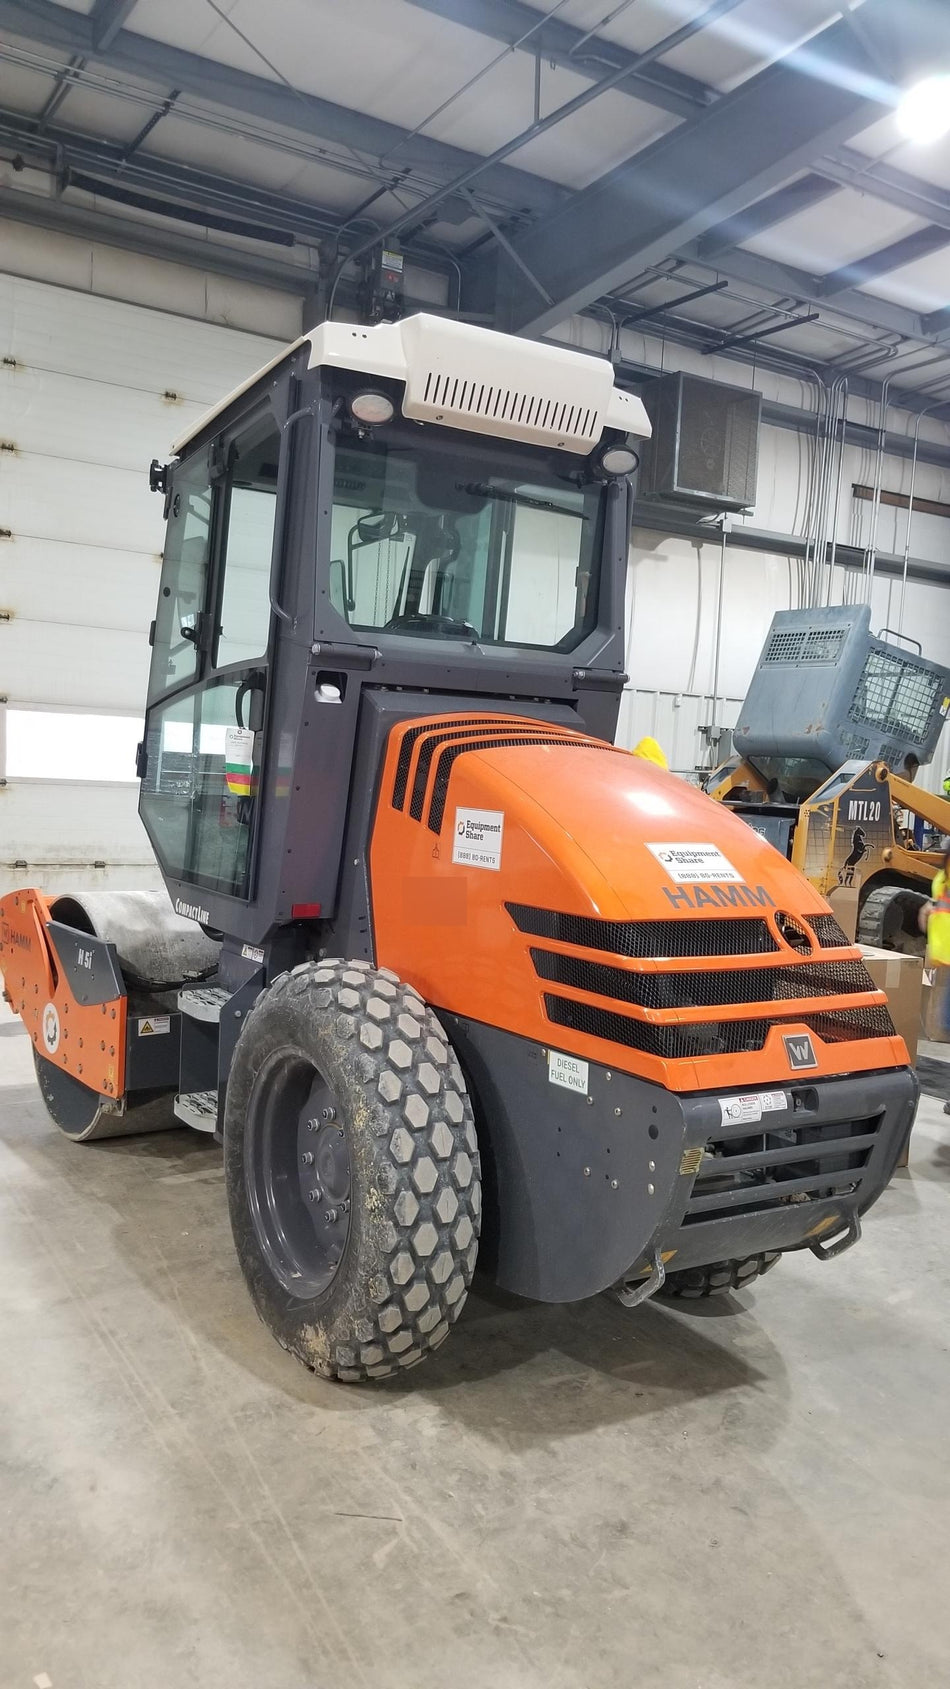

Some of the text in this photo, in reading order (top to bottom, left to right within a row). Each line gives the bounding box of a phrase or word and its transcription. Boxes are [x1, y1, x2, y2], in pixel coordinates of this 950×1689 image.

[848, 800, 881, 822] MTL20
[465, 830, 484, 841] Share
[466, 820, 501, 833] Equipment
[670, 850, 721, 858] Equipment
[662, 885, 777, 909] HAMM
[10, 929, 32, 952] HAMM
[557, 1058, 580, 1074] DIESEL
[551, 1069, 586, 1089] FUEL ONLY
